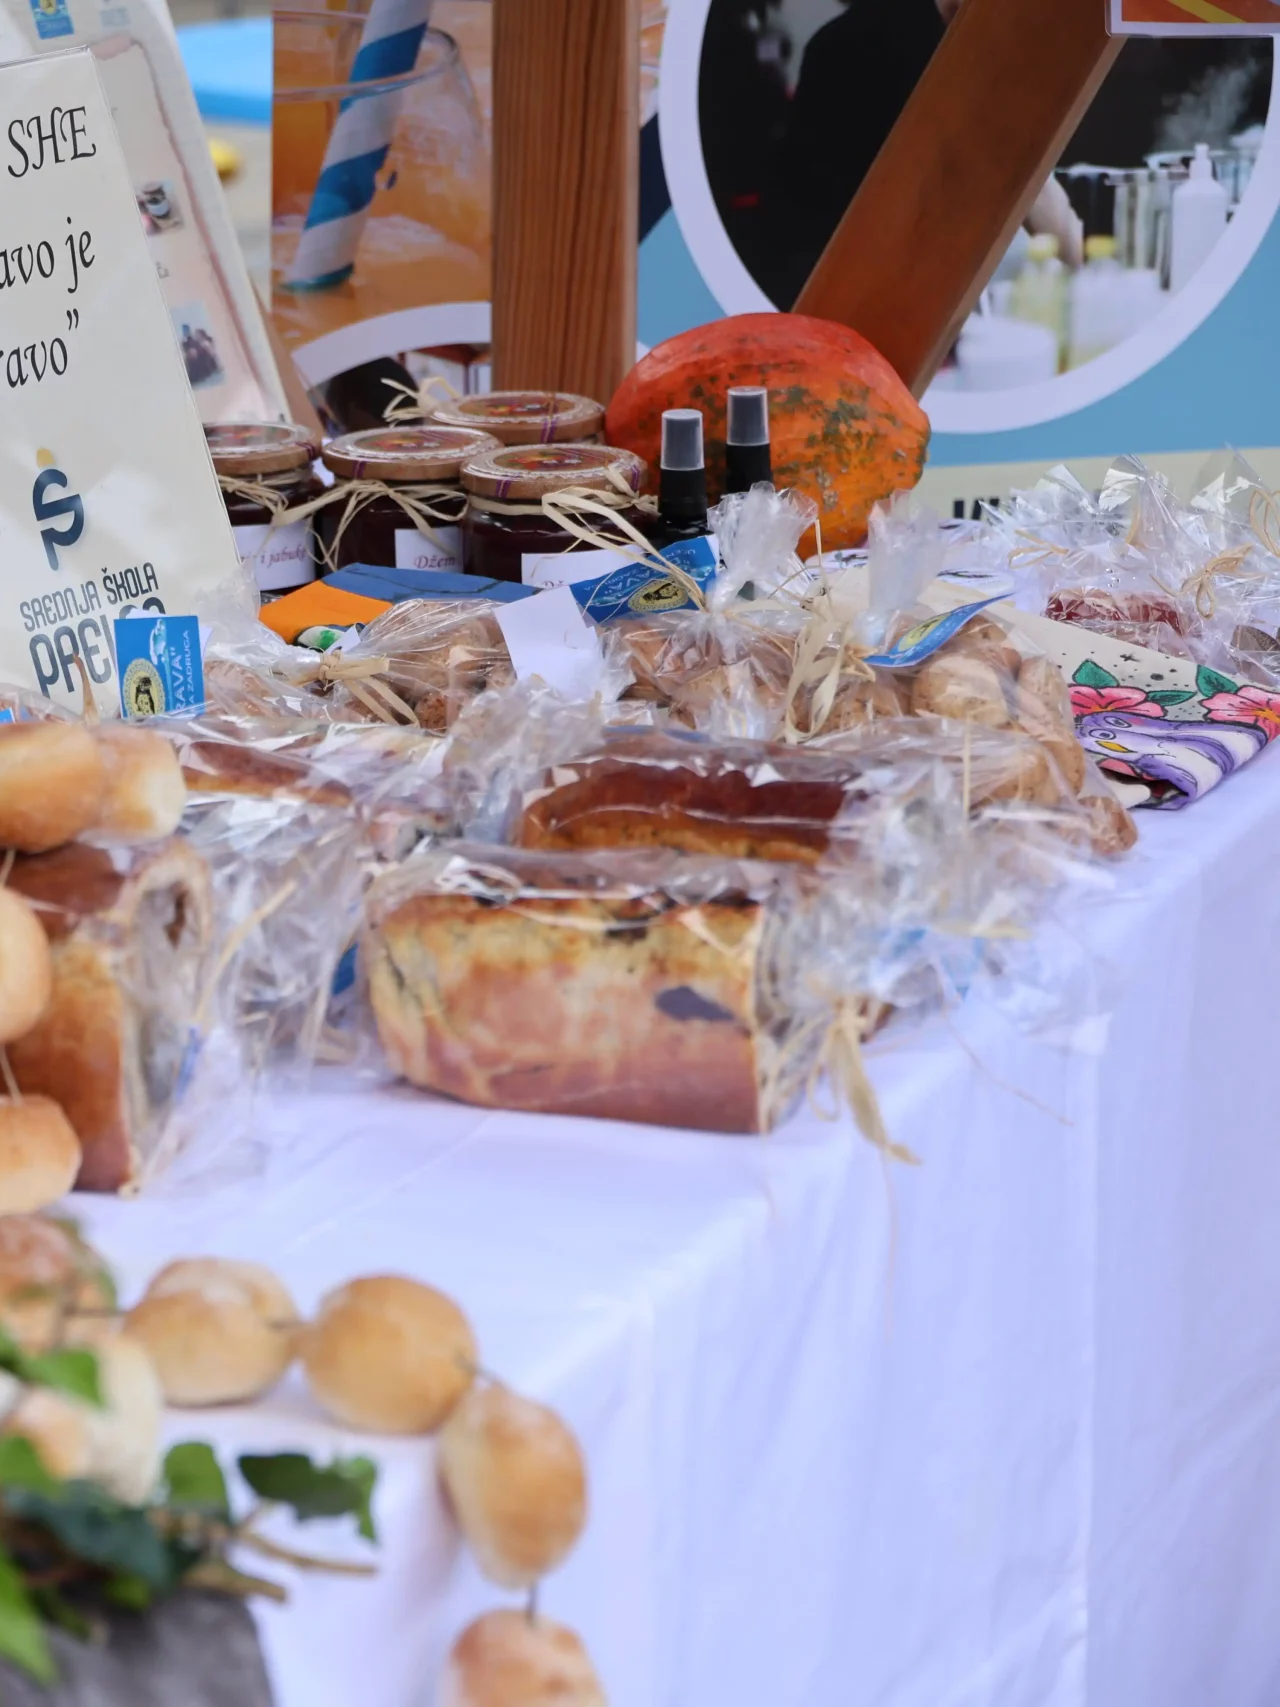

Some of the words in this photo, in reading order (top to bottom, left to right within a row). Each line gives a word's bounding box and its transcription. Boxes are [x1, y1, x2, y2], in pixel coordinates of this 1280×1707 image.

[7, 106, 97, 178] SHE
[65, 216, 96, 294] je
[20, 580, 102, 632] SREDNJA
[102, 562, 159, 604] ŠKOLA
[29, 596, 167, 700] PRE
[182, 629, 194, 692] ZADRUGA
